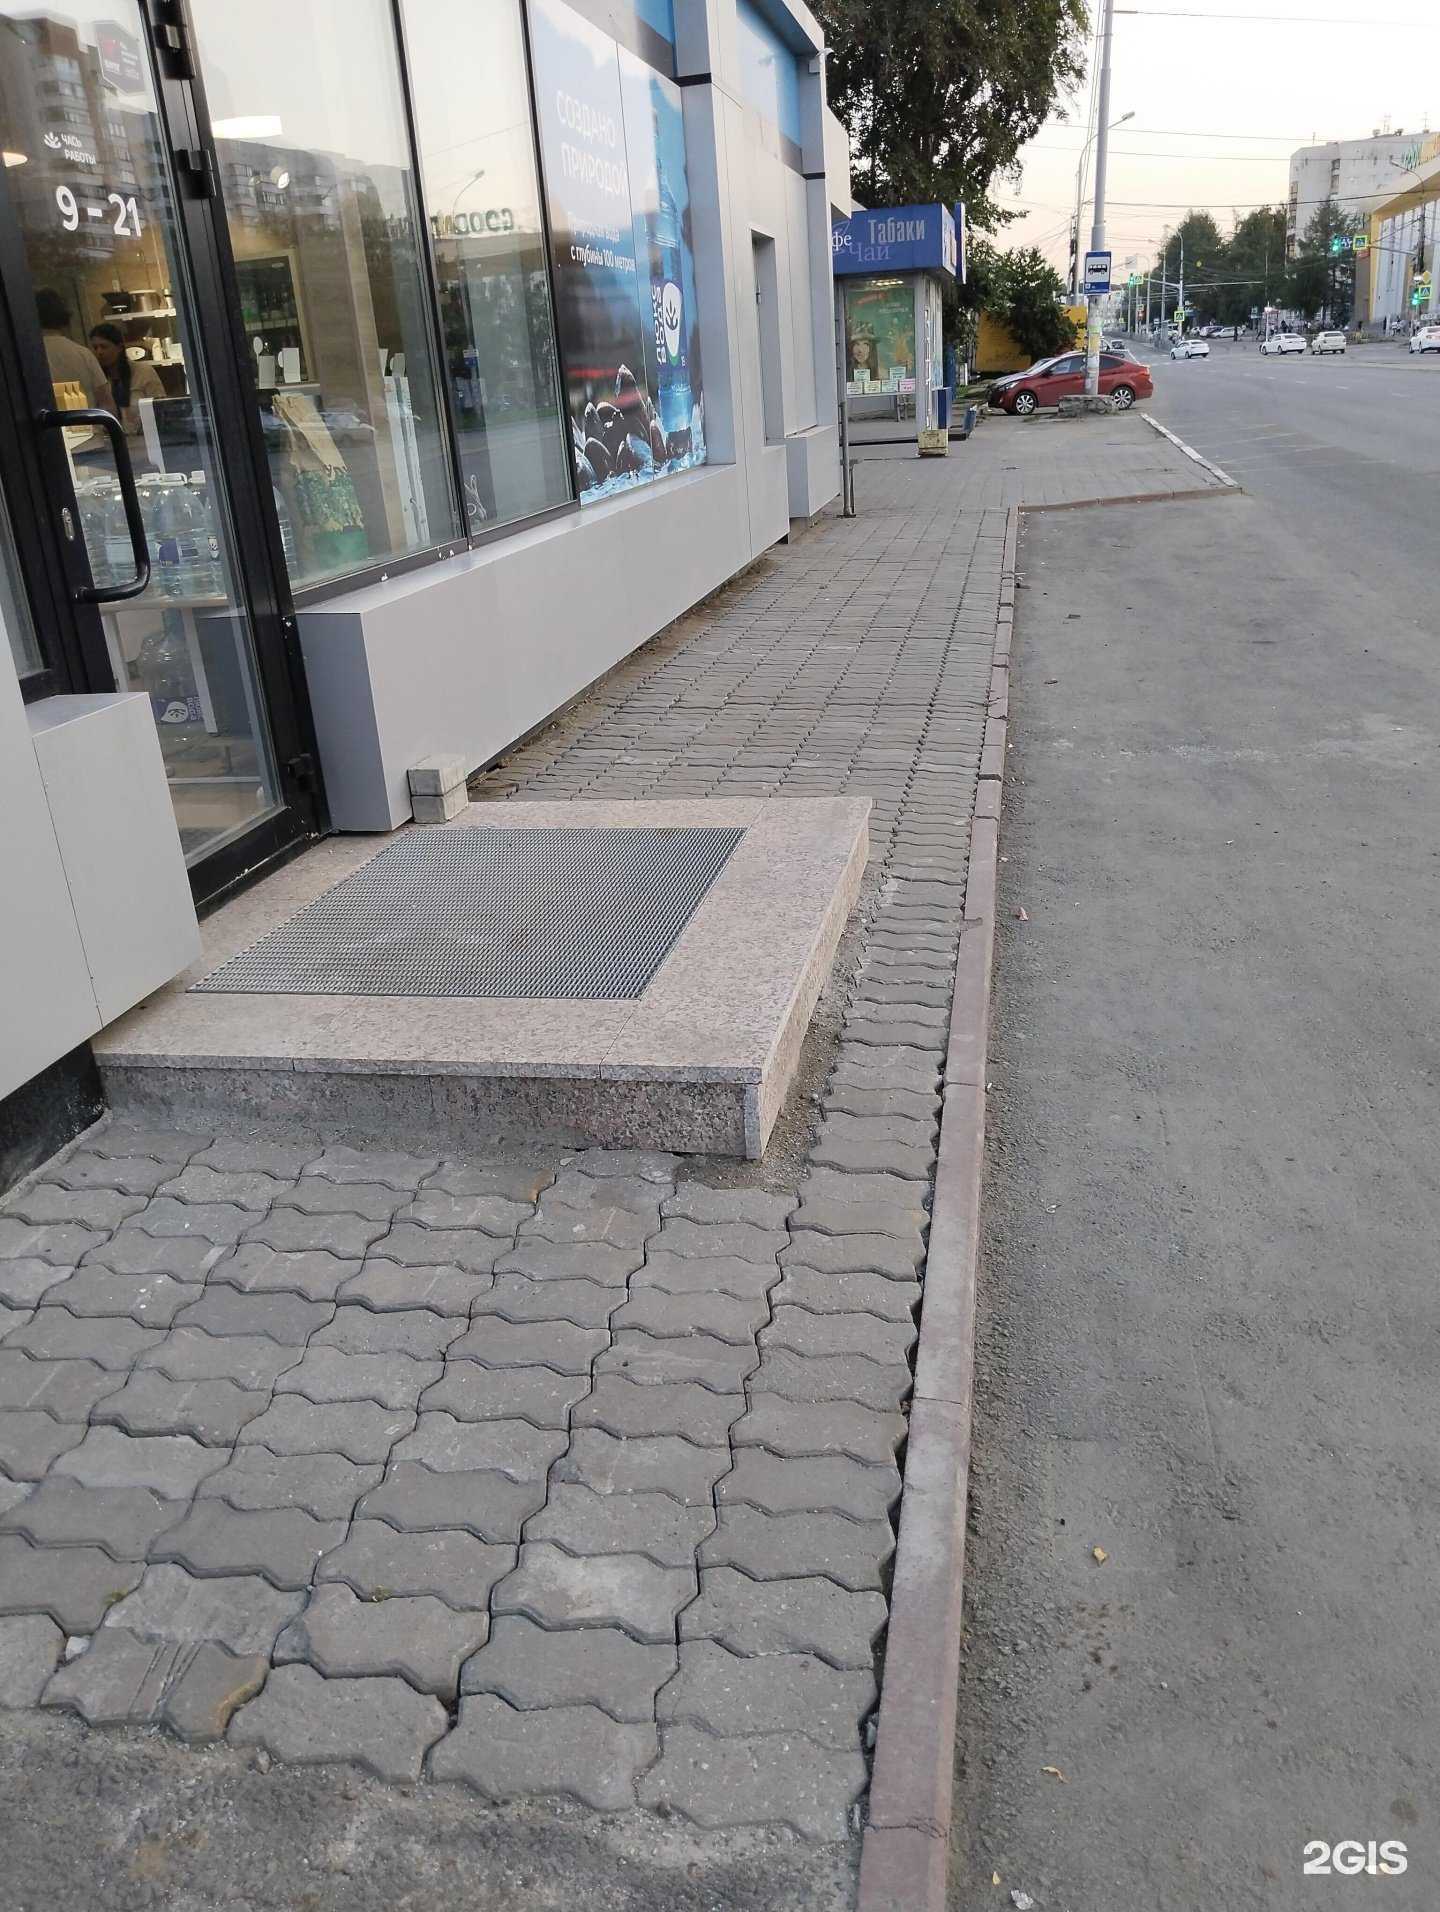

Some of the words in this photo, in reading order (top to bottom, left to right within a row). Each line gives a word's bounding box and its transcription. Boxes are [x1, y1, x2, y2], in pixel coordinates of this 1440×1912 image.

[556, 90, 616, 149] СОЗДАНО
[64, 149, 96, 165] РАБОТЫ
[55, 185, 79, 231] 9
[108, 193, 142, 237] 21
[831, 231, 852, 252] фе
[868, 217, 926, 245] Табаки
[575, 244, 604, 268] глубины
